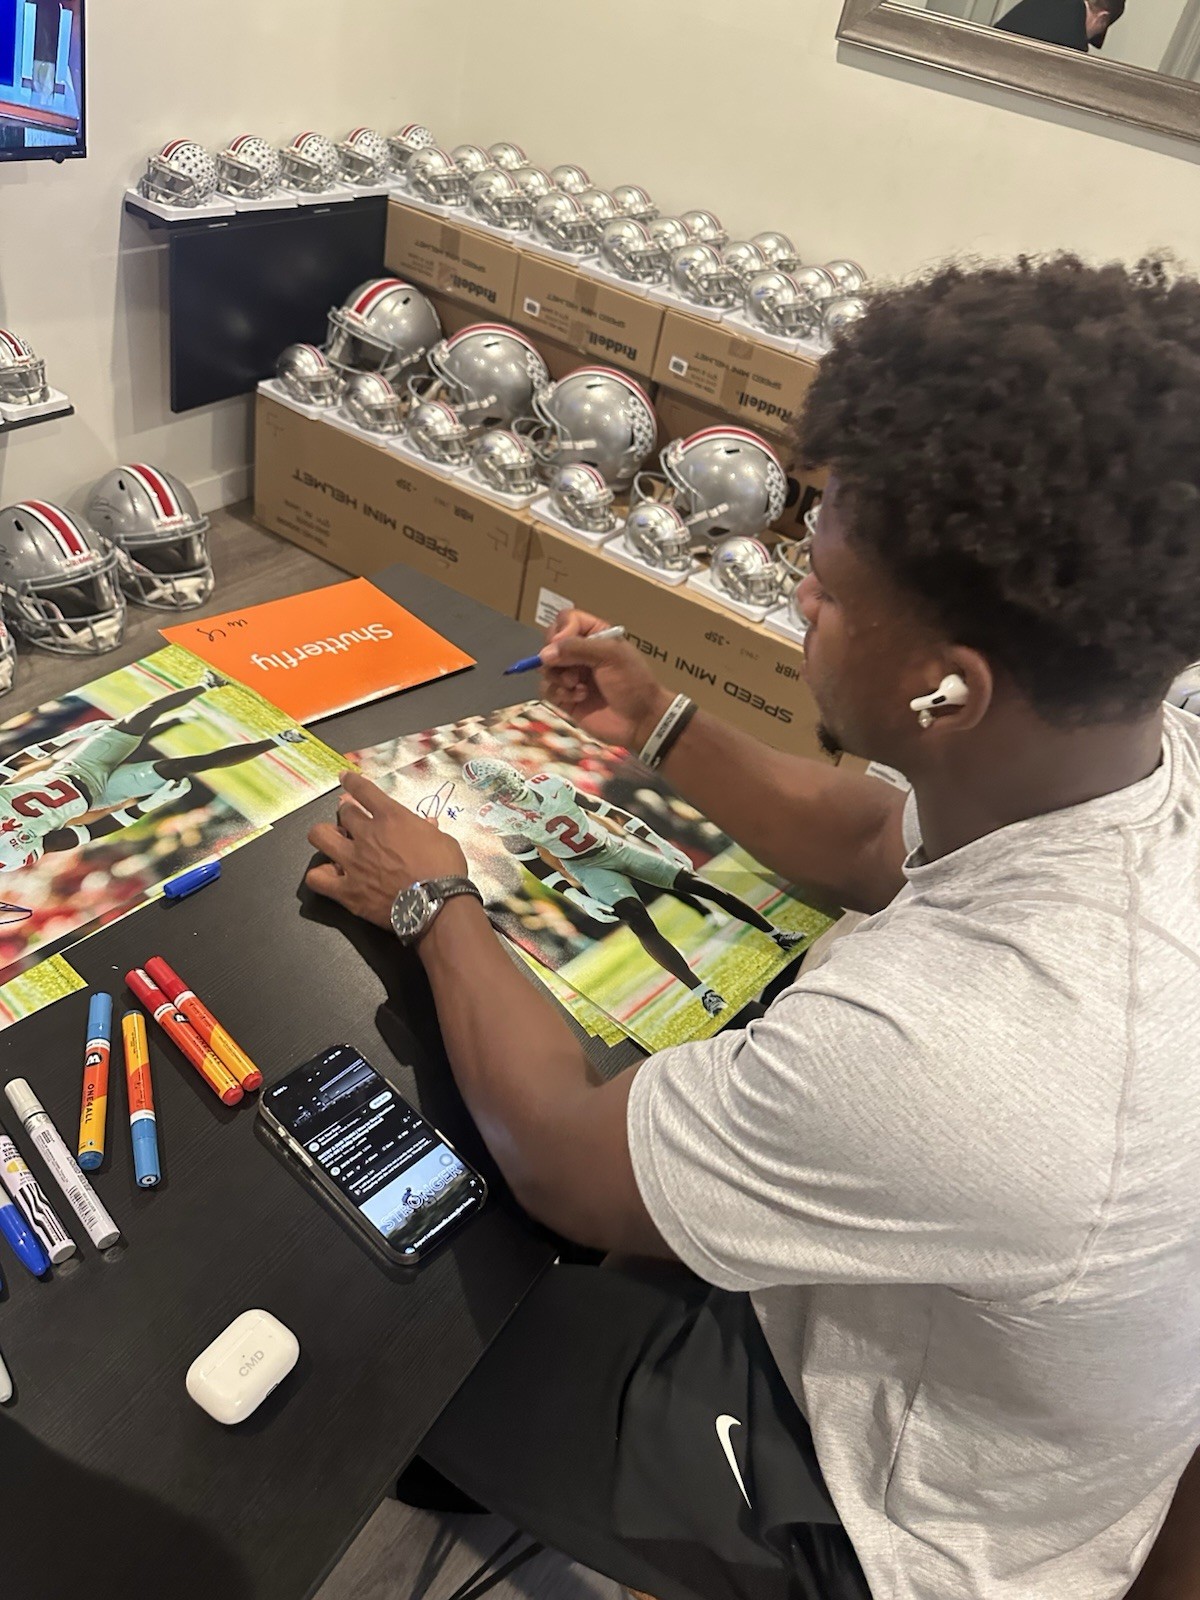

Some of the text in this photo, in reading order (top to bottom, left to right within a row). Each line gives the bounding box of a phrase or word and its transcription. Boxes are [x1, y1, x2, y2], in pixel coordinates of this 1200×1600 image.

[452, 275, 496, 304] Riddell
[598, 313, 626, 329] SPEED
[588, 331, 638, 361] Riddell
[694, 351, 782, 390] SPEED MINI HELMET
[738, 391, 793, 421] Riddell
[291, 468, 358, 511] HELMET
[362, 502, 398, 531] MINI
[401, 523, 460, 564] SPEED
[251, 622, 395, 672] Shutterfly
[674, 656, 718, 686] MINI
[774, 661, 801, 682] HBR
[722, 680, 795, 725] SPEED
[11, 778, 81, 818] 2
[544, 814, 599, 854] 2
[83, 1082, 95, 1125] ONE4ALL
[380, 1163, 463, 1231] STRONGER
[238, 1350, 265, 1377] CMD
